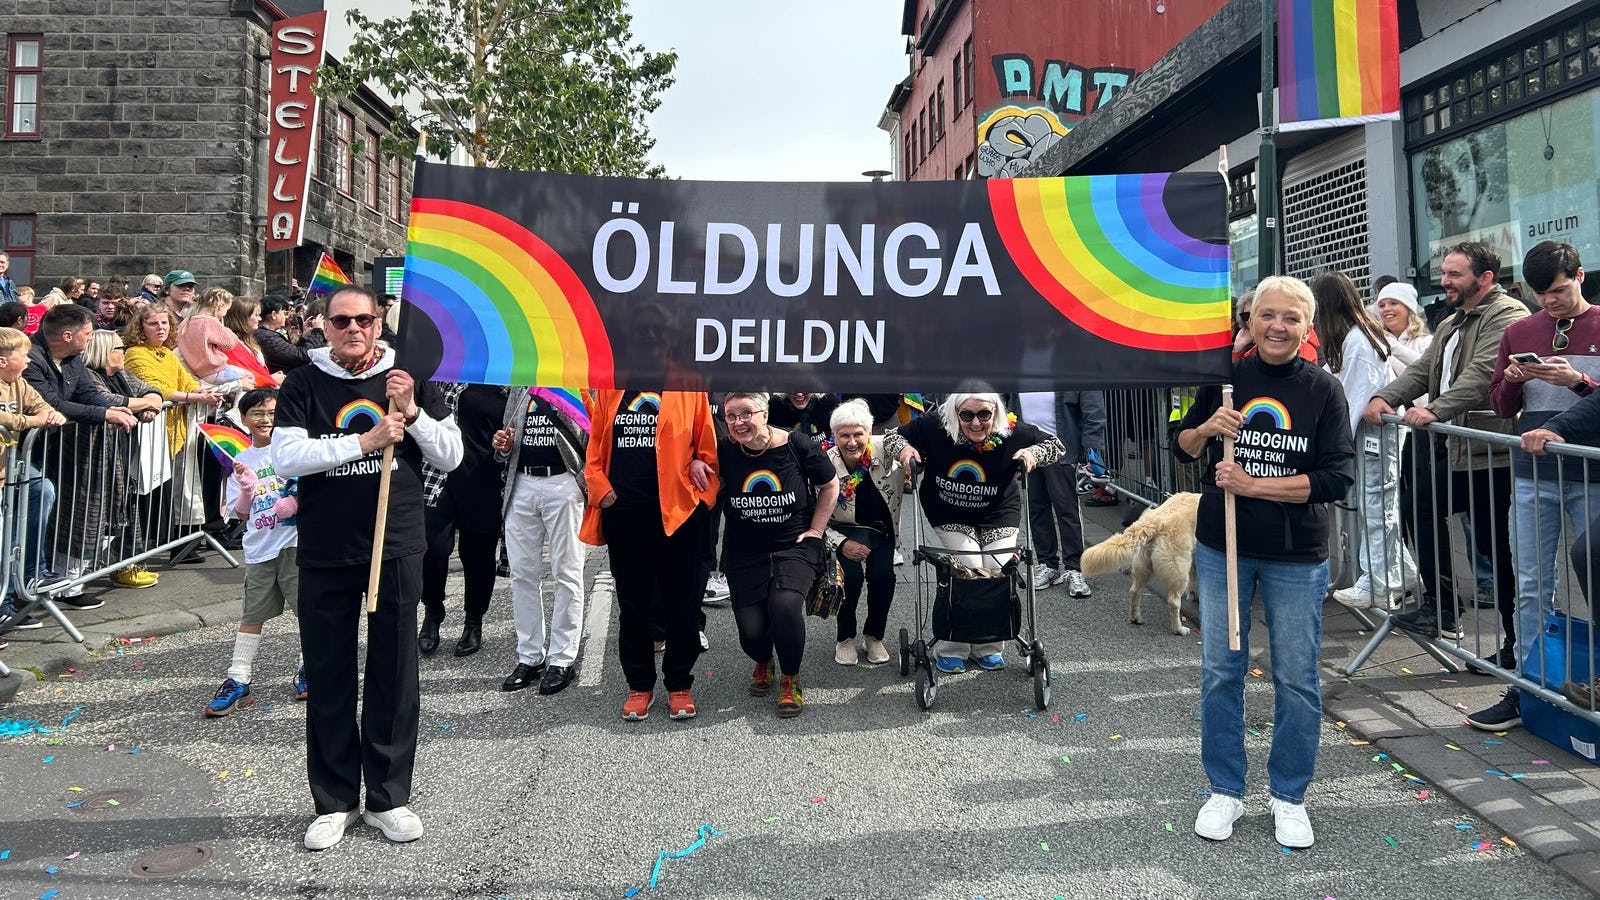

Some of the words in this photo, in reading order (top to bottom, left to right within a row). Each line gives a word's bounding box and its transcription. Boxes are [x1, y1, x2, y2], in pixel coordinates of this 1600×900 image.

[271, 26, 316, 240] STELLA
[1528, 215, 1579, 237] aurum
[592, 201, 1002, 297] ÖLDUNGA
[695, 318, 886, 364] DEILDIN
[624, 426, 649, 435] DOFNAR
[1216, 430, 1308, 453] GNBOGINN
[1234, 446, 1262, 460] OFNAR
[1264, 451, 1285, 463] EKKI
[935, 475, 998, 496] REGNBOGINN
[730, 491, 796, 508] REGNBOGINN
[768, 507, 783, 515] EKKI
